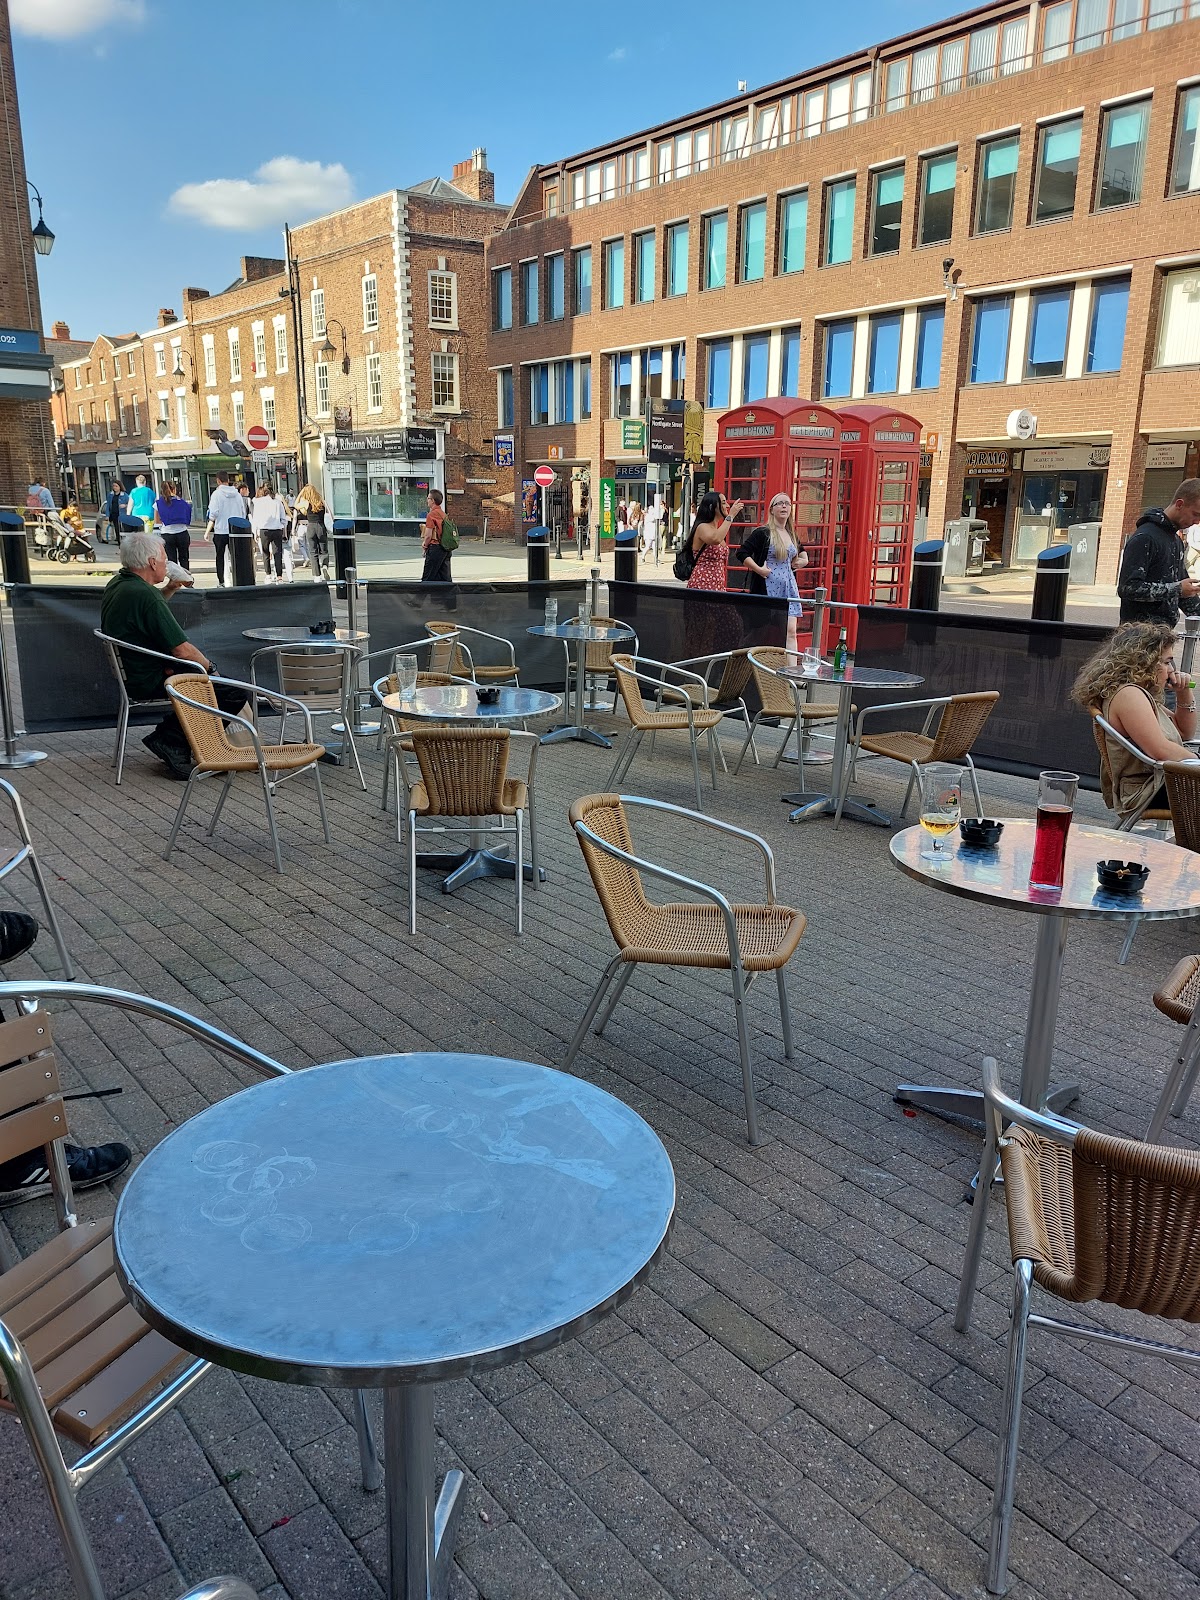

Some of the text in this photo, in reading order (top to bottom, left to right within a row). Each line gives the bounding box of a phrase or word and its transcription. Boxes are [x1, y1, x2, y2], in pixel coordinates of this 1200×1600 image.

[0, 335, 17, 344] 022
[728, 426, 775, 436] TELEPHONE
[792, 426, 833, 438] TELEPHONE
[876, 432, 913, 442] TELEPHONE
[340, 435, 383, 451] Rihanna Nails
